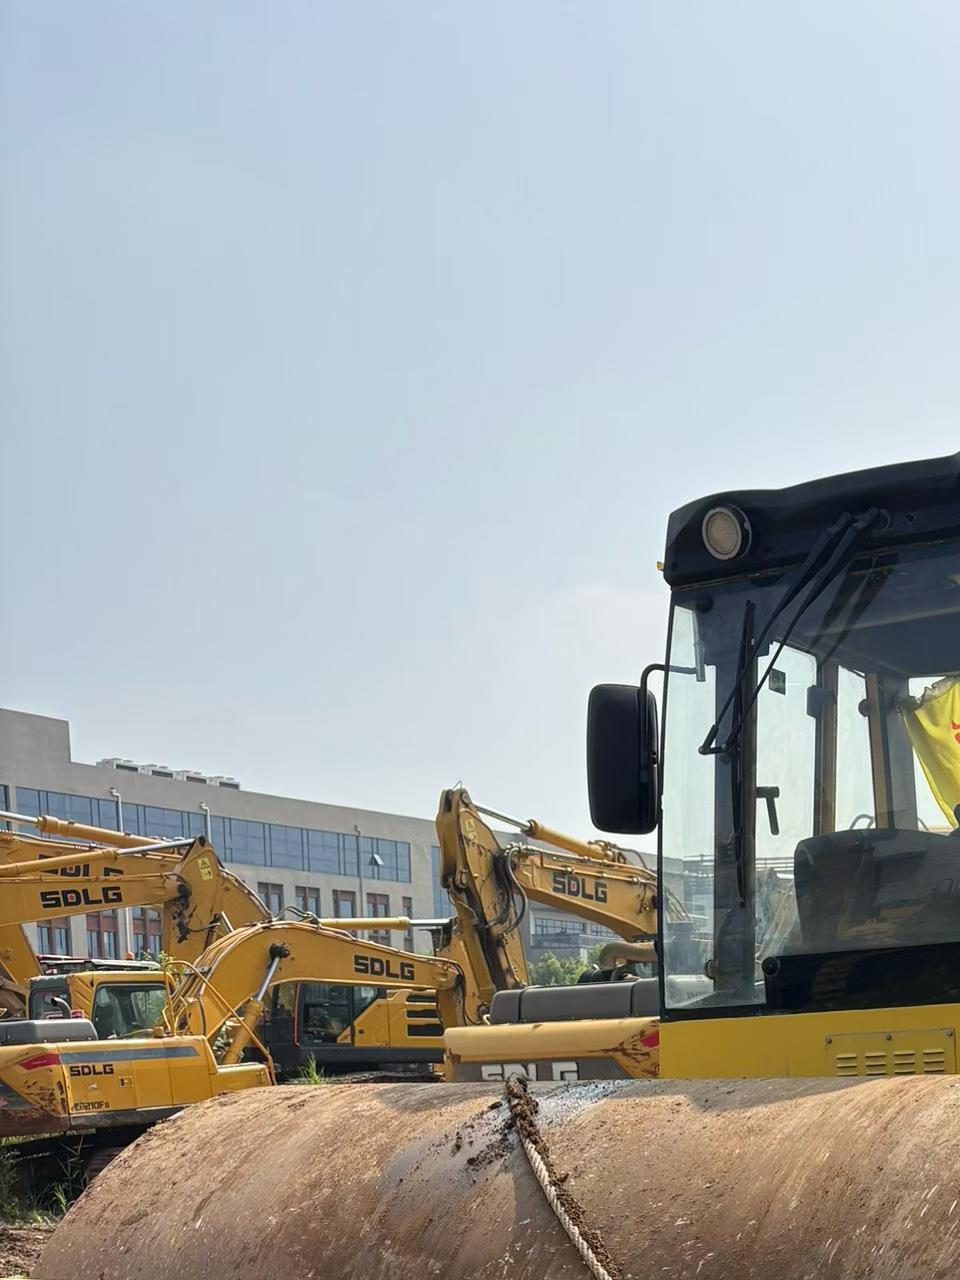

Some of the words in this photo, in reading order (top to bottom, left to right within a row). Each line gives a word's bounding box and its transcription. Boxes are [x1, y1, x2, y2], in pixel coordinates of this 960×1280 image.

[40, 886, 122, 908] SDLG
[552, 871, 608, 904] SDLG
[354, 955, 415, 980] SDLG
[70, 1064, 114, 1076] SDLG
